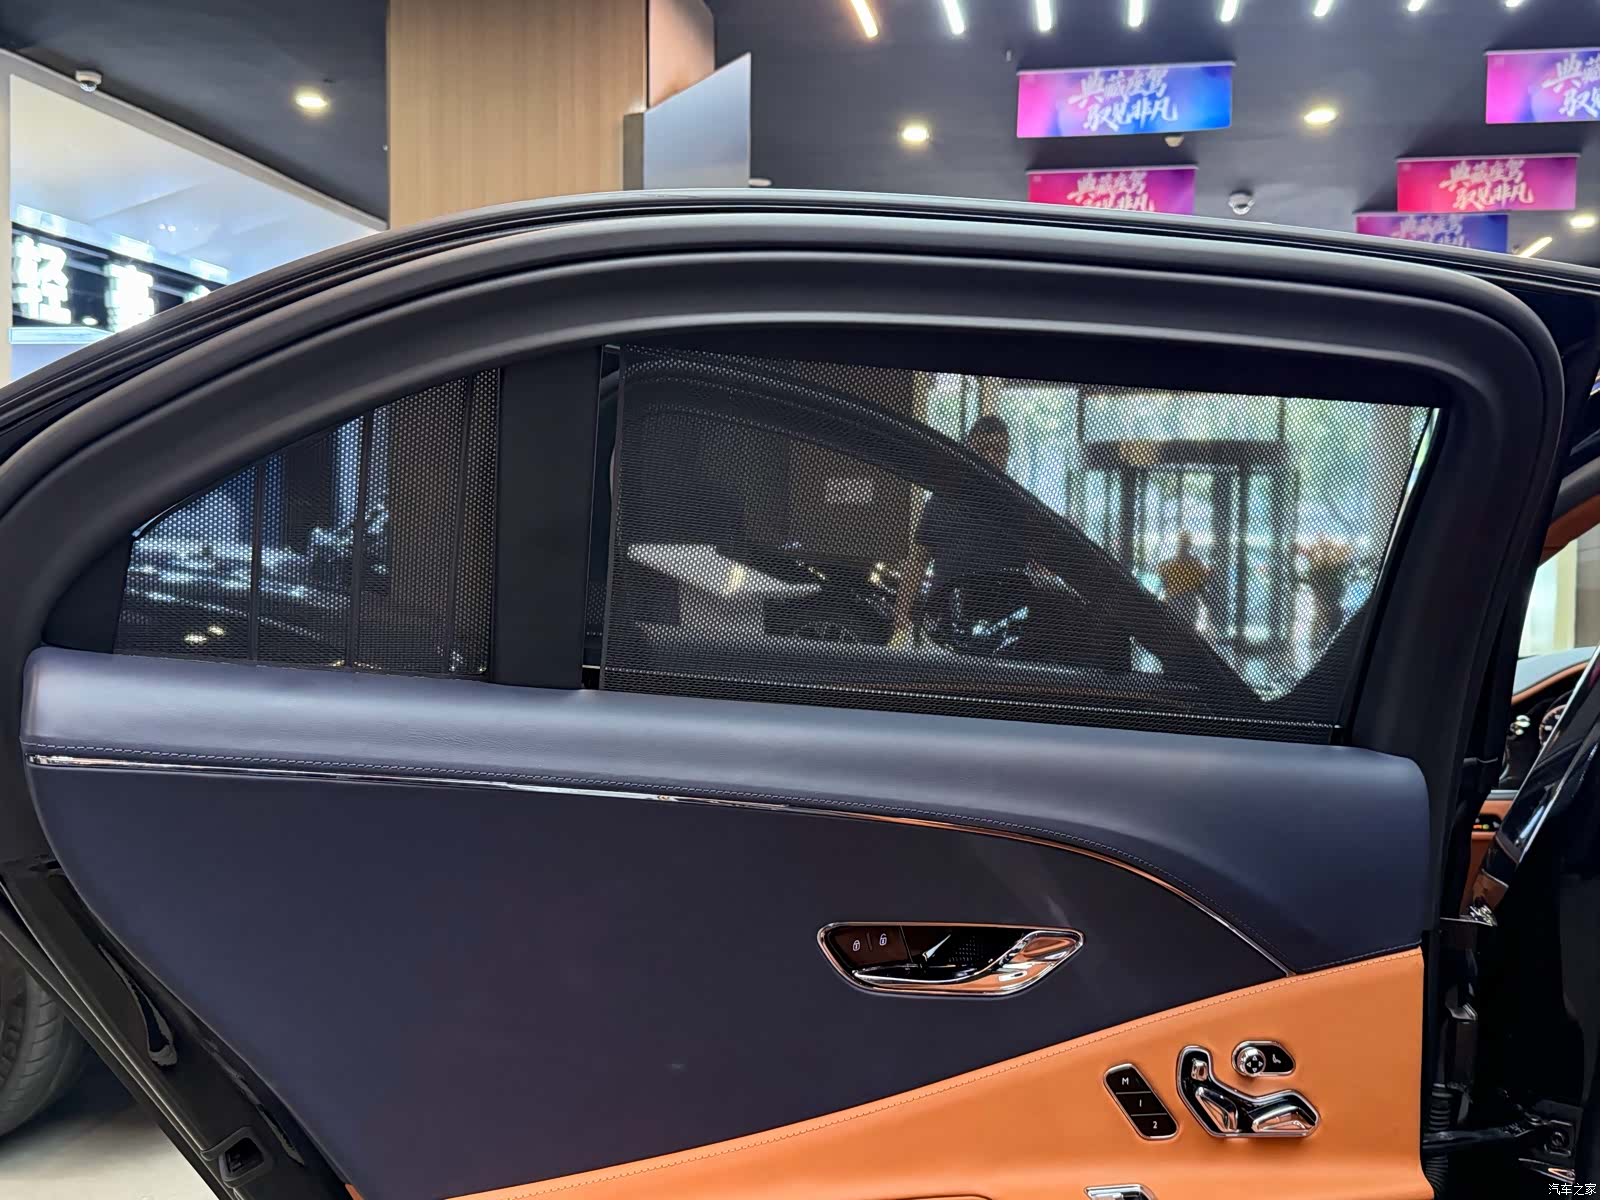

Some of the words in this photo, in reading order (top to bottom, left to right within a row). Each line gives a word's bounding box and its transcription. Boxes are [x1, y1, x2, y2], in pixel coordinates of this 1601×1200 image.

[1068, 67, 1169, 109] 典藏座驾
[1066, 171, 1149, 204] 典藏座驾
[1439, 158, 1526, 192] 典藏座驾
[1121, 1077, 1129, 1085] M
[1152, 1120, 1158, 1129] 2
